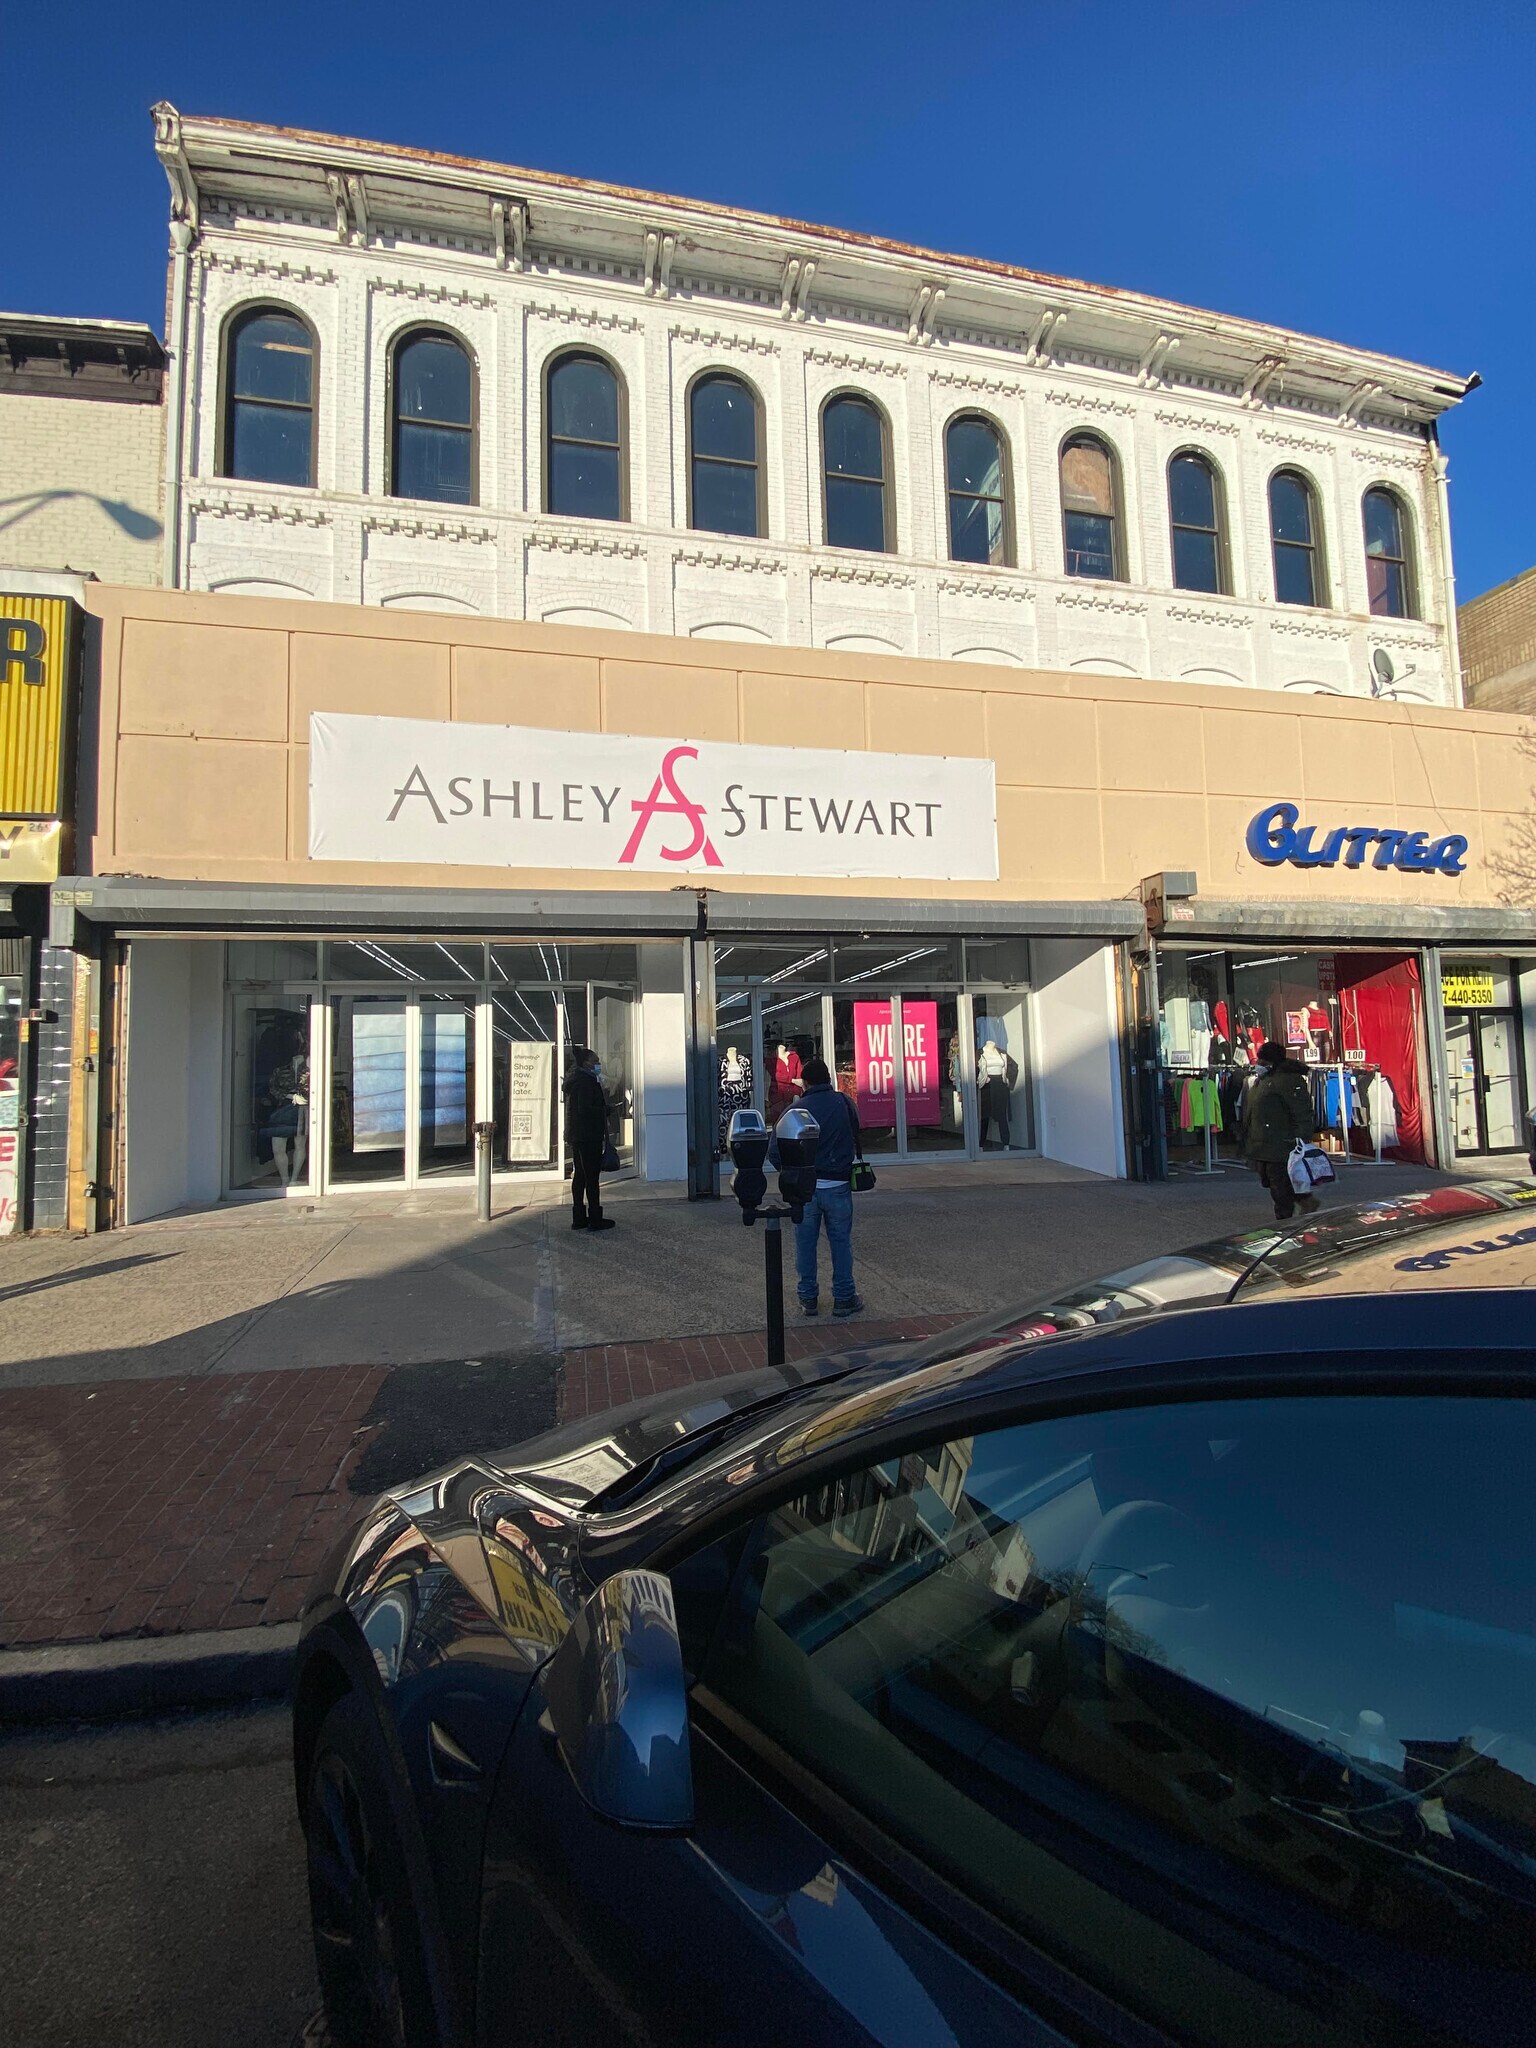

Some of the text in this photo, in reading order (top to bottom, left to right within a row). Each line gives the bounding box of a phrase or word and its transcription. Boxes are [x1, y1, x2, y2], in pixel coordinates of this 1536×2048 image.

[386, 764, 621, 825] ASHLEY
[721, 784, 942, 838] STEWART
[1246, 802, 1468, 877] GLITTER
[1455, 966, 1471, 986] FOR
[1347, 1051, 1364, 1060] 1.00
[513, 1063, 534, 1073] Shop
[868, 1060, 928, 1095] OPN!
[513, 1080, 529, 1088] Pay
